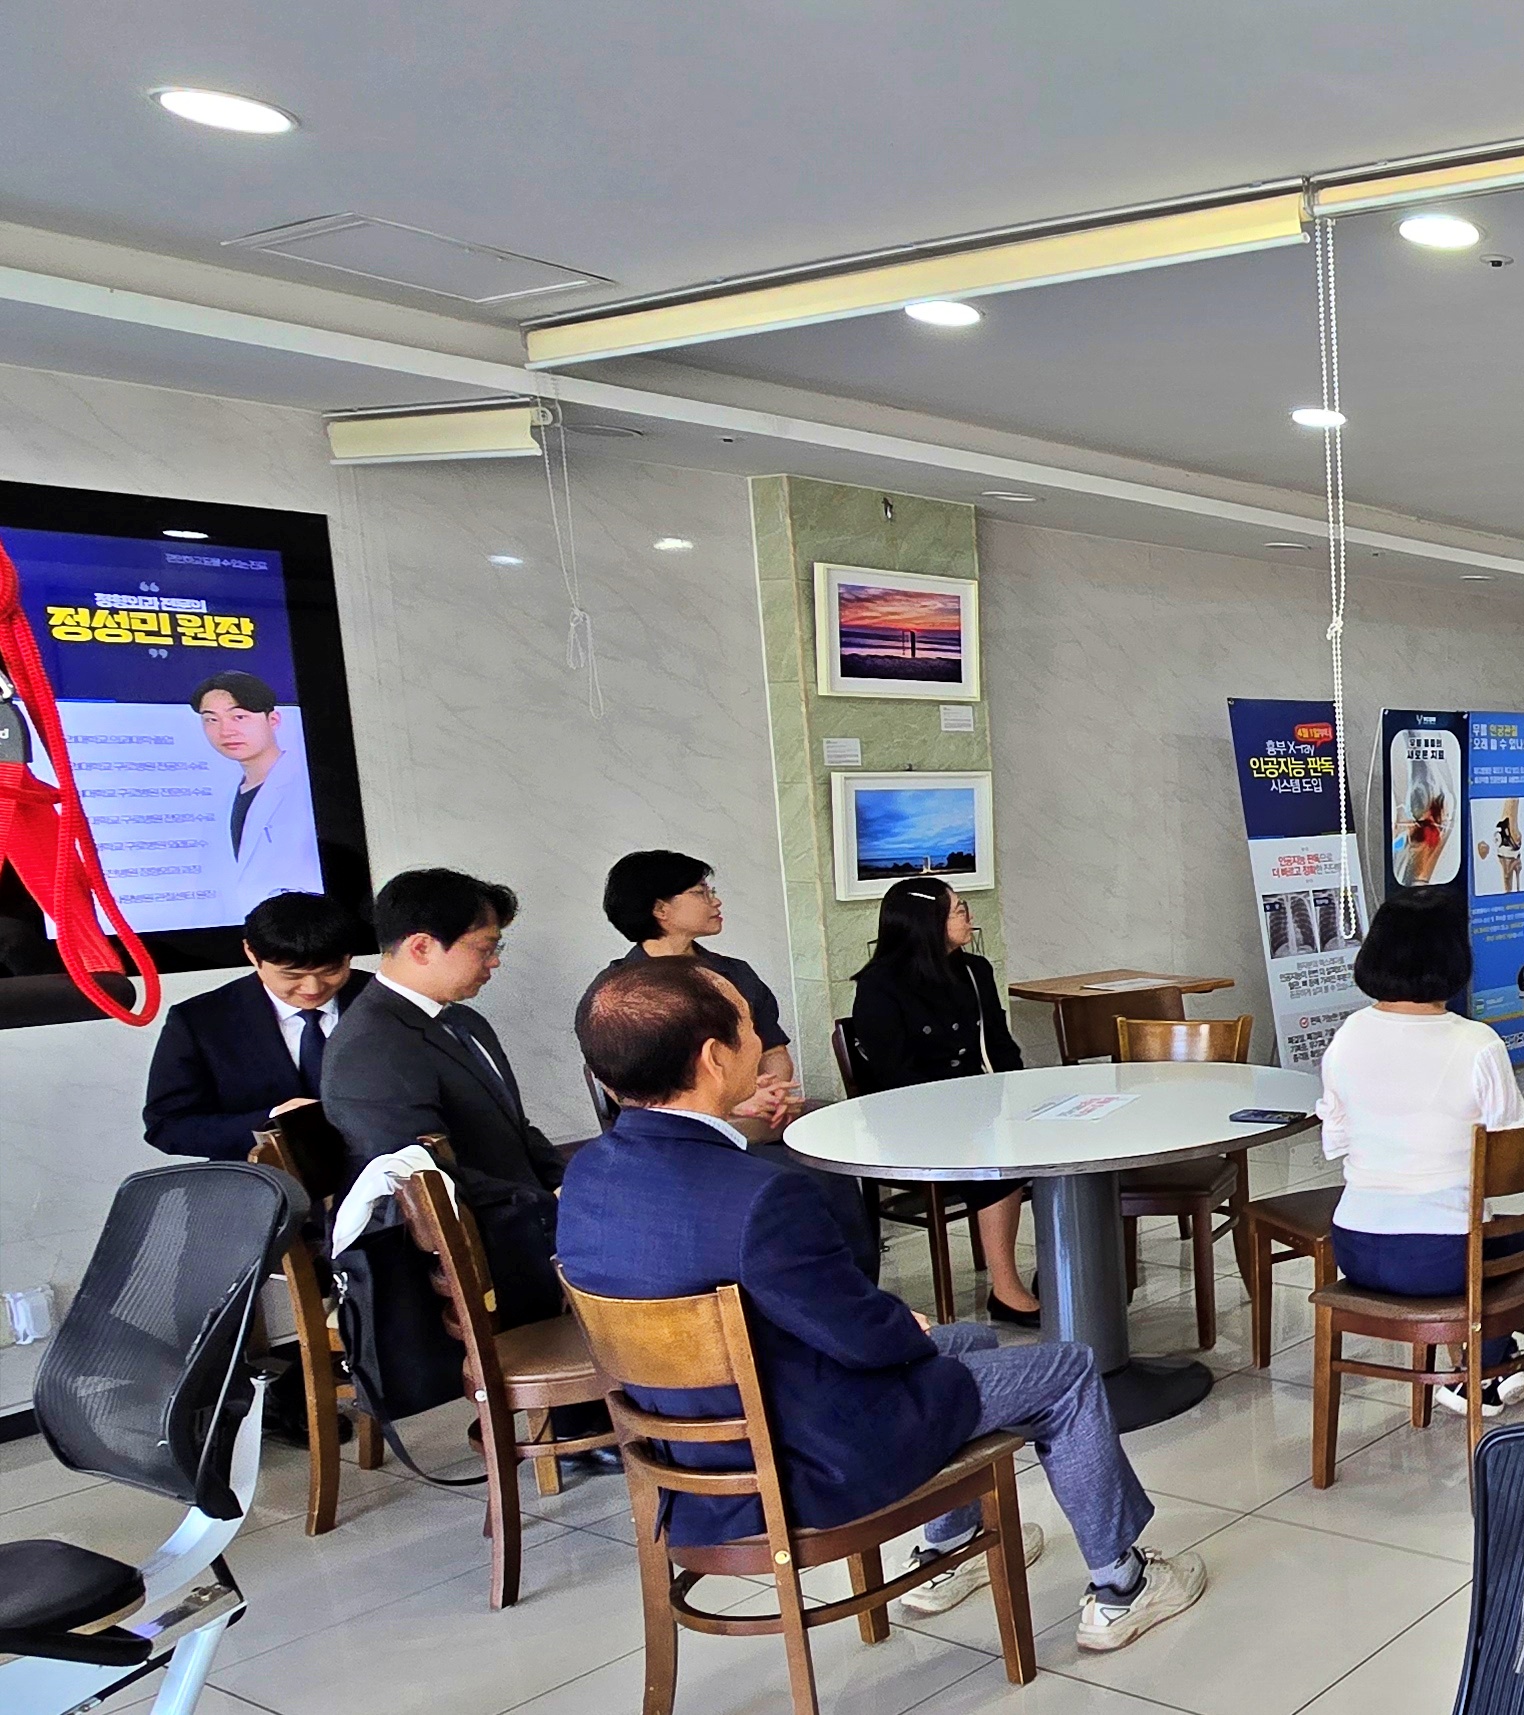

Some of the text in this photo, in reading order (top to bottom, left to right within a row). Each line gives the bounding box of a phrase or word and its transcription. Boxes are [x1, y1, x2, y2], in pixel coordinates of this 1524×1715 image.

[46, 606, 254, 649] 정성민 원장
[1489, 724, 1518, 736] 인공관절
[1265, 740, 1315, 756] 흉부 X-ray
[1473, 739, 1489, 750] 오래
[1499, 738, 1507, 749] 수
[1250, 757, 1335, 778] 인공지능 판독
[1270, 778, 1323, 794] 시스템 도입
[1278, 855, 1306, 867] 인공지능
[1272, 868, 1281, 879] 더
